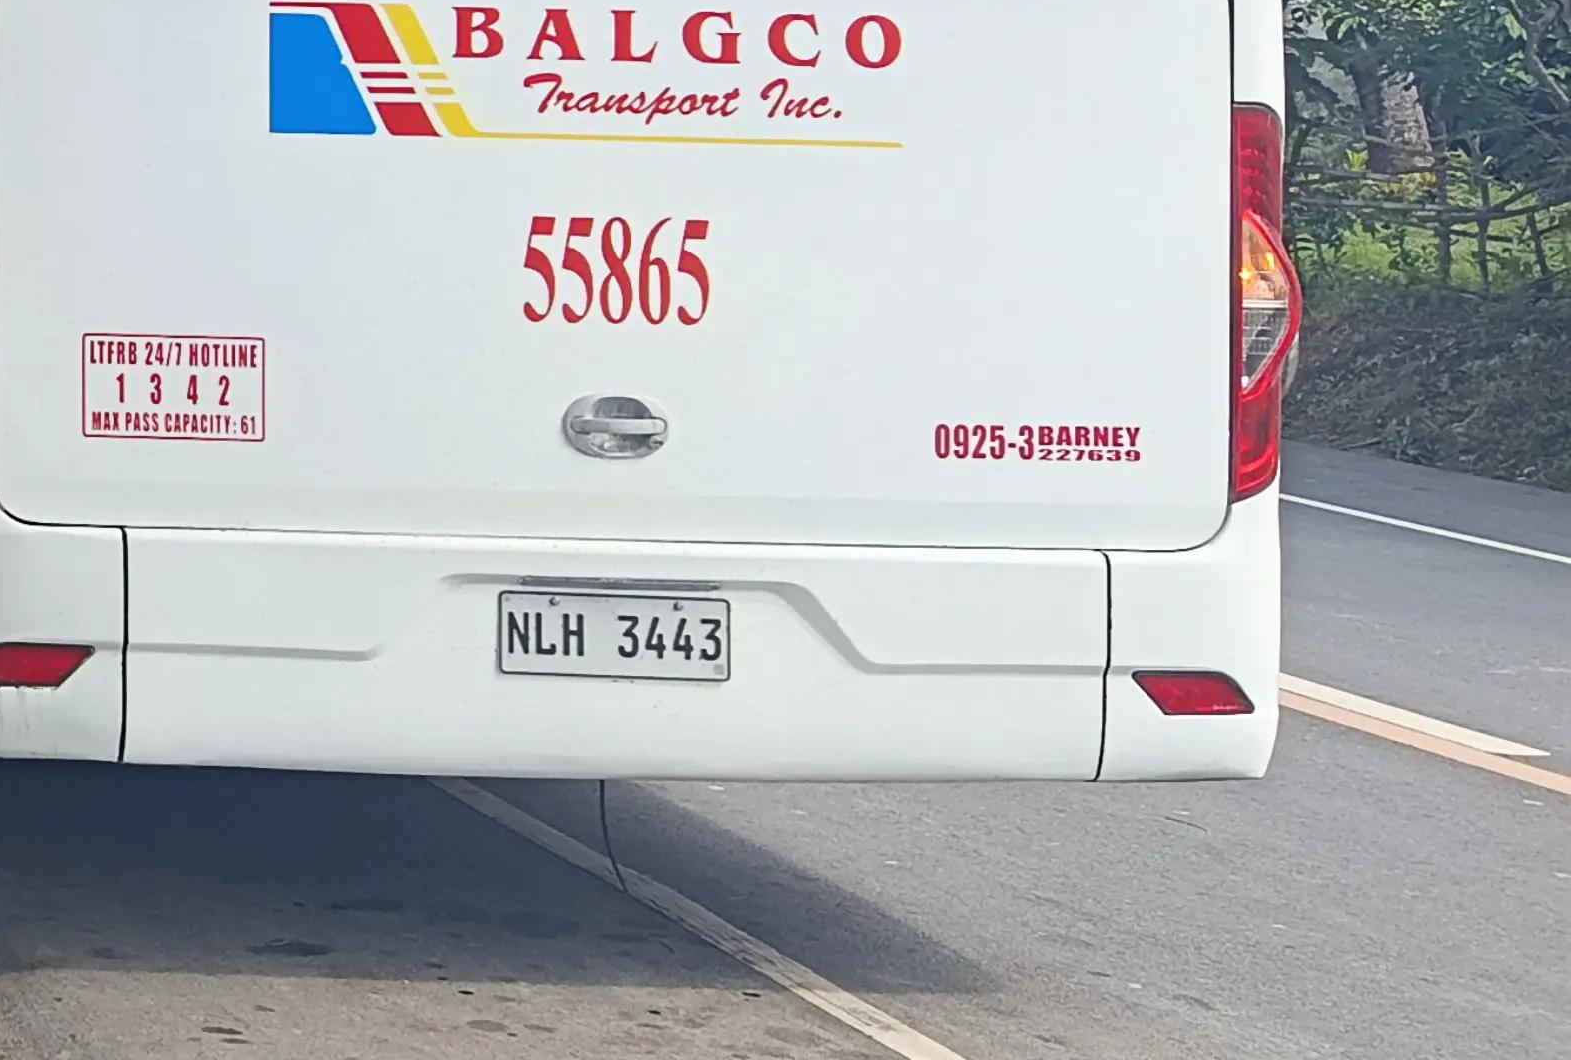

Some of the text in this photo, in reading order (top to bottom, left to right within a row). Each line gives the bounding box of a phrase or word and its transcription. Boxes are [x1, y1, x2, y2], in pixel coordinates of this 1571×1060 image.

[453, 6, 903, 70] BALGCO
[522, 72, 843, 124] Transport Inc.
[523, 215, 712, 327] 55865
[90, 340, 258, 368] LTFRB 24/7 HOTLINE
[91, 411, 257, 435] MAX PASS CAPACITY: 61
[934, 423, 1142, 461] 0925-3 BARNEY
[1038, 448, 1142, 462] 227639
[507, 611, 722, 661] NLH 3443
